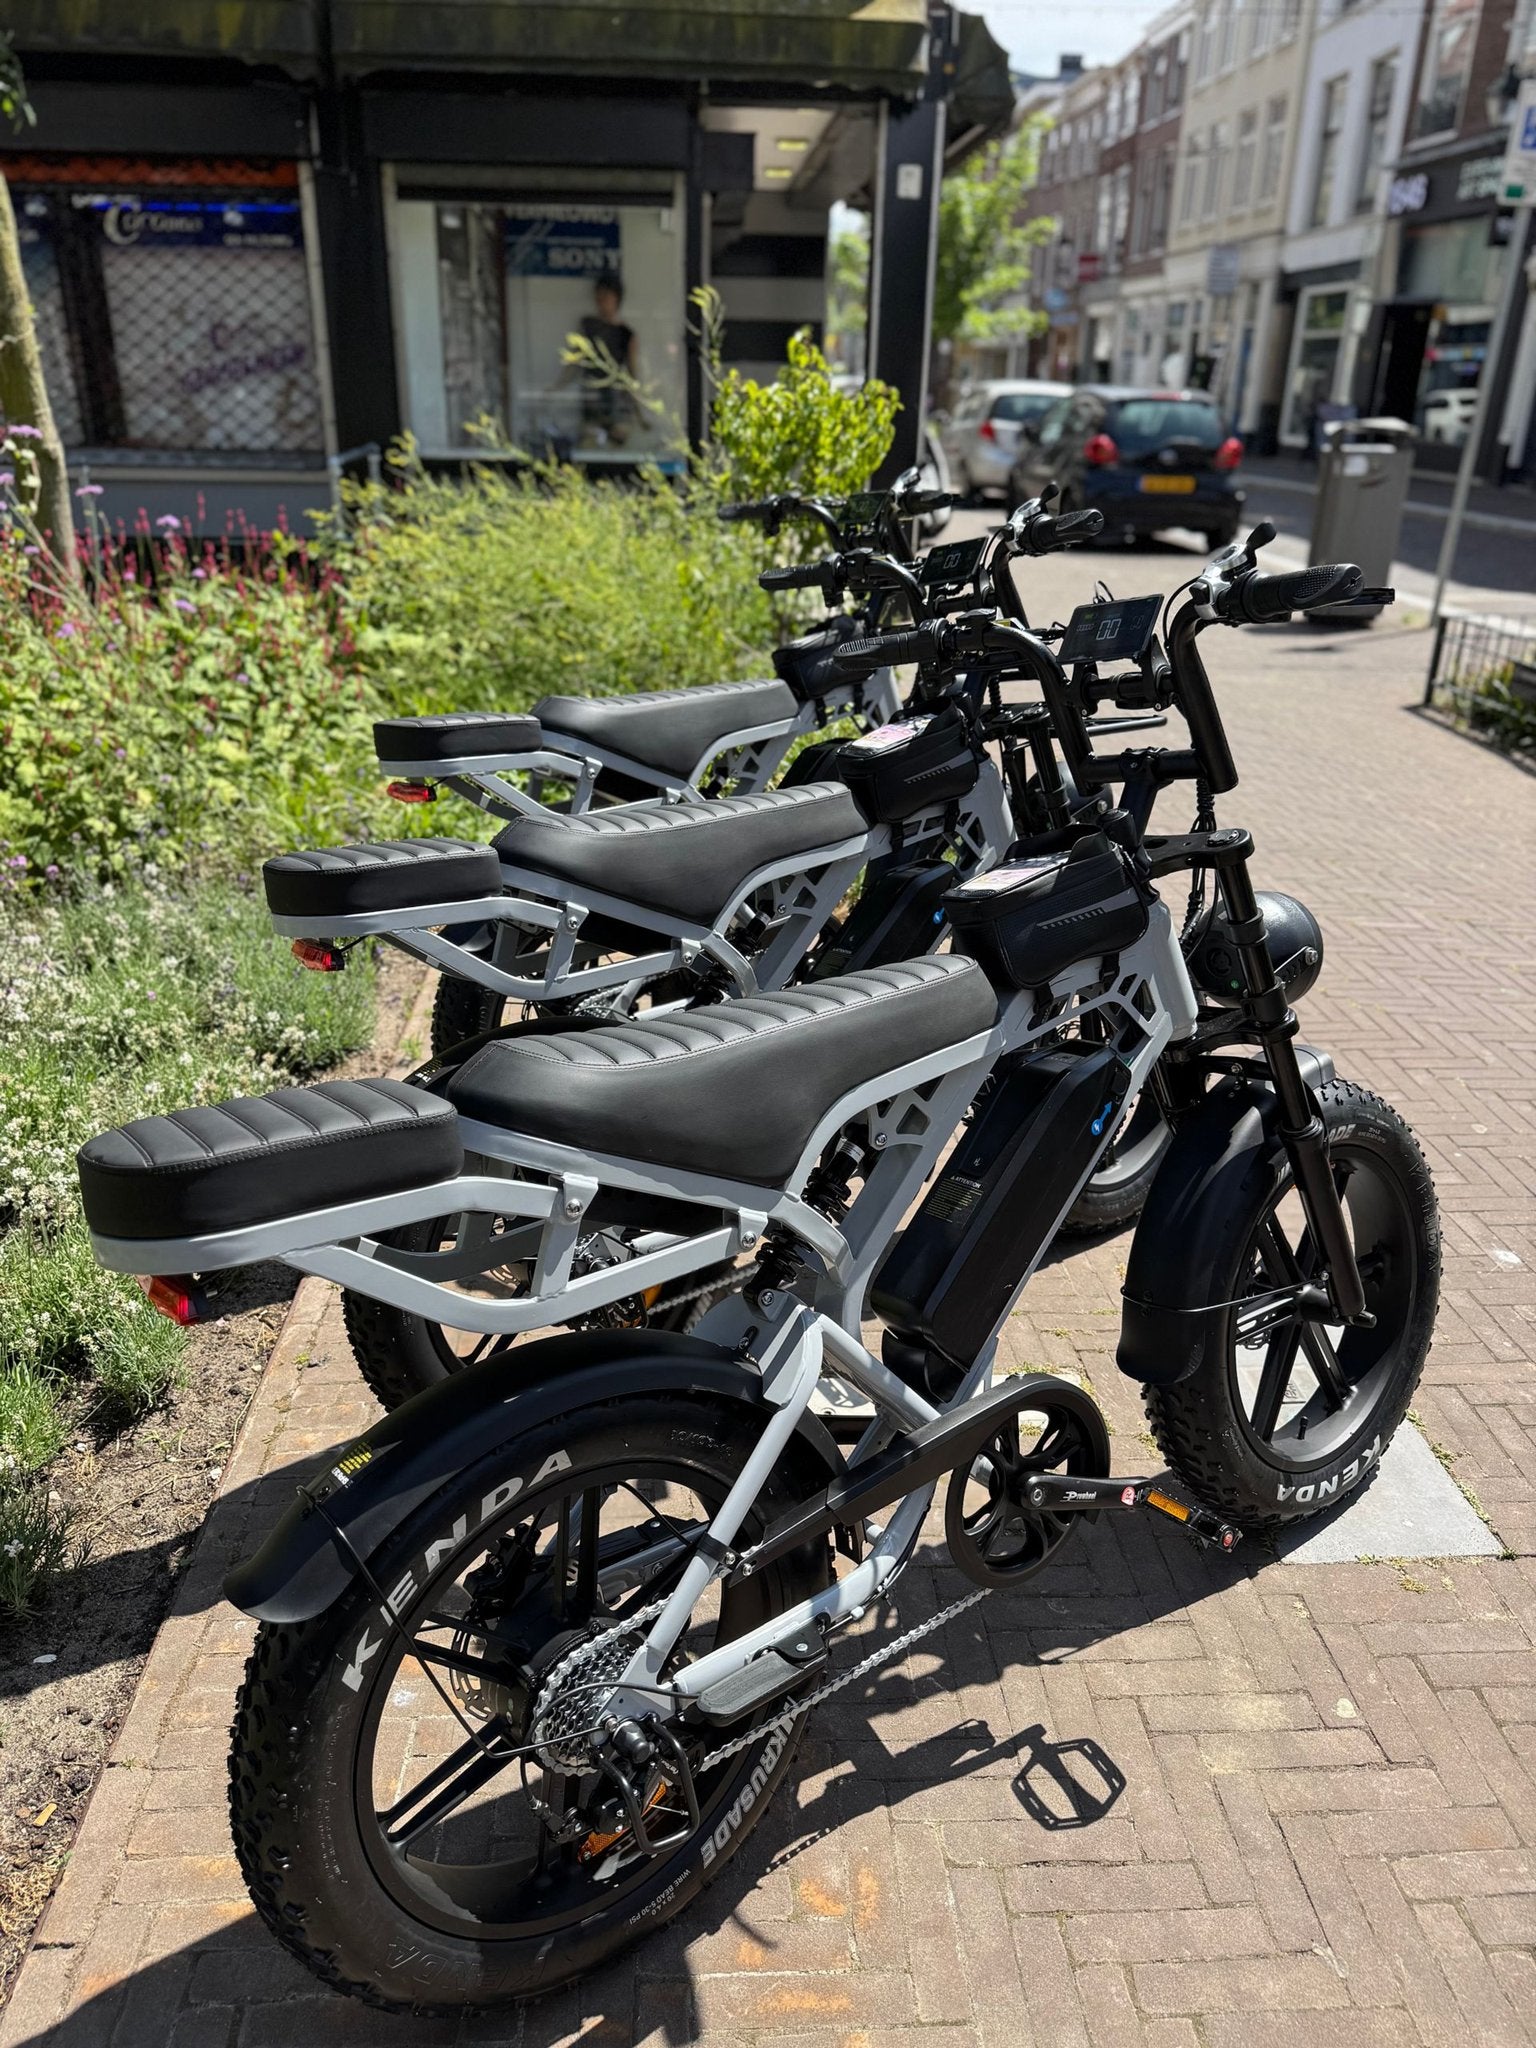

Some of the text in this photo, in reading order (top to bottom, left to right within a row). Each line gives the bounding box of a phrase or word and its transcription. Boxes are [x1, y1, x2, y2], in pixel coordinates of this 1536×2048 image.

[547, 247, 621, 269] SONY
[1276, 1433, 1381, 1503] KENDA
[341, 1449, 573, 1693] KENDA
[700, 1725, 789, 1870] KRUSADE
[628, 1869, 691, 1925] WIRE BEAD 5-30 PSI
